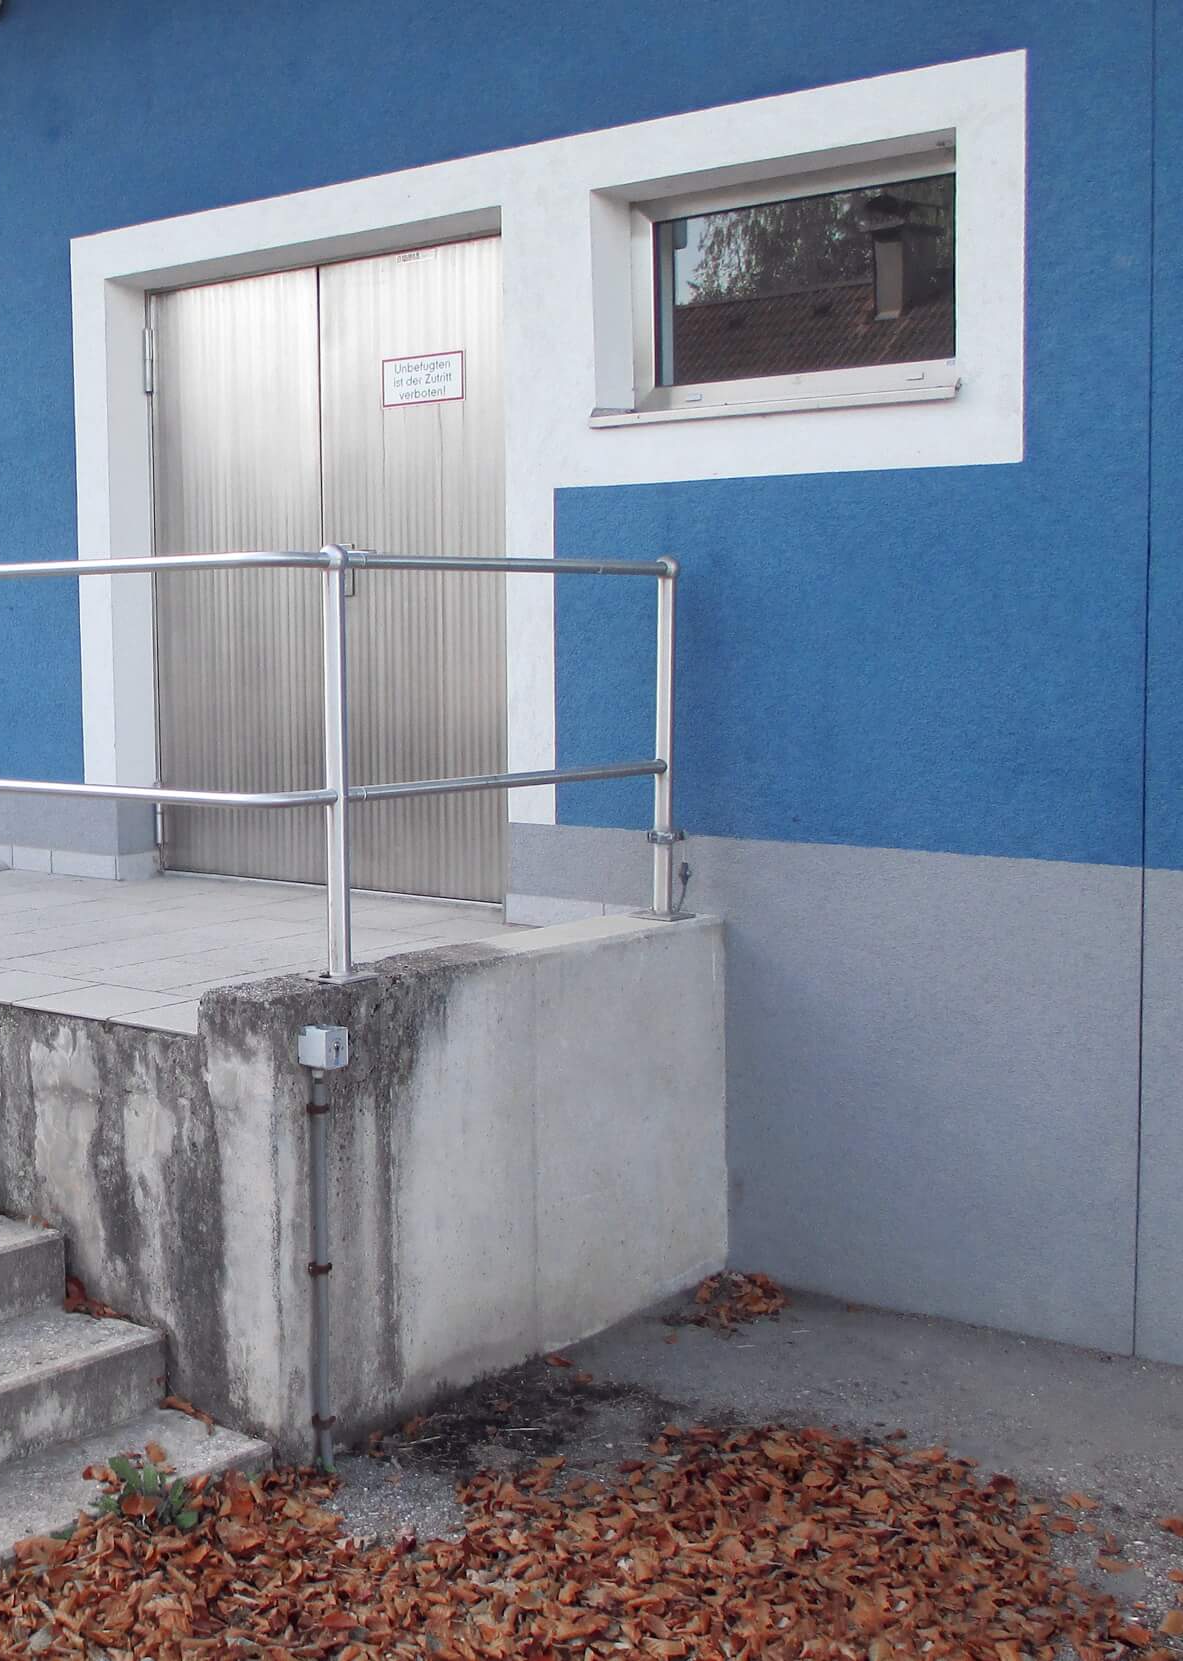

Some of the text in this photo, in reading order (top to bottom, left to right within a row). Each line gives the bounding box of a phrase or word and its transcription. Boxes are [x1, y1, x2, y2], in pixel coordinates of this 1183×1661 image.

[394, 360, 451, 374] Unbefugten
[393, 372, 452, 388] ist der Zutritt
[399, 386, 446, 400] verboten!
